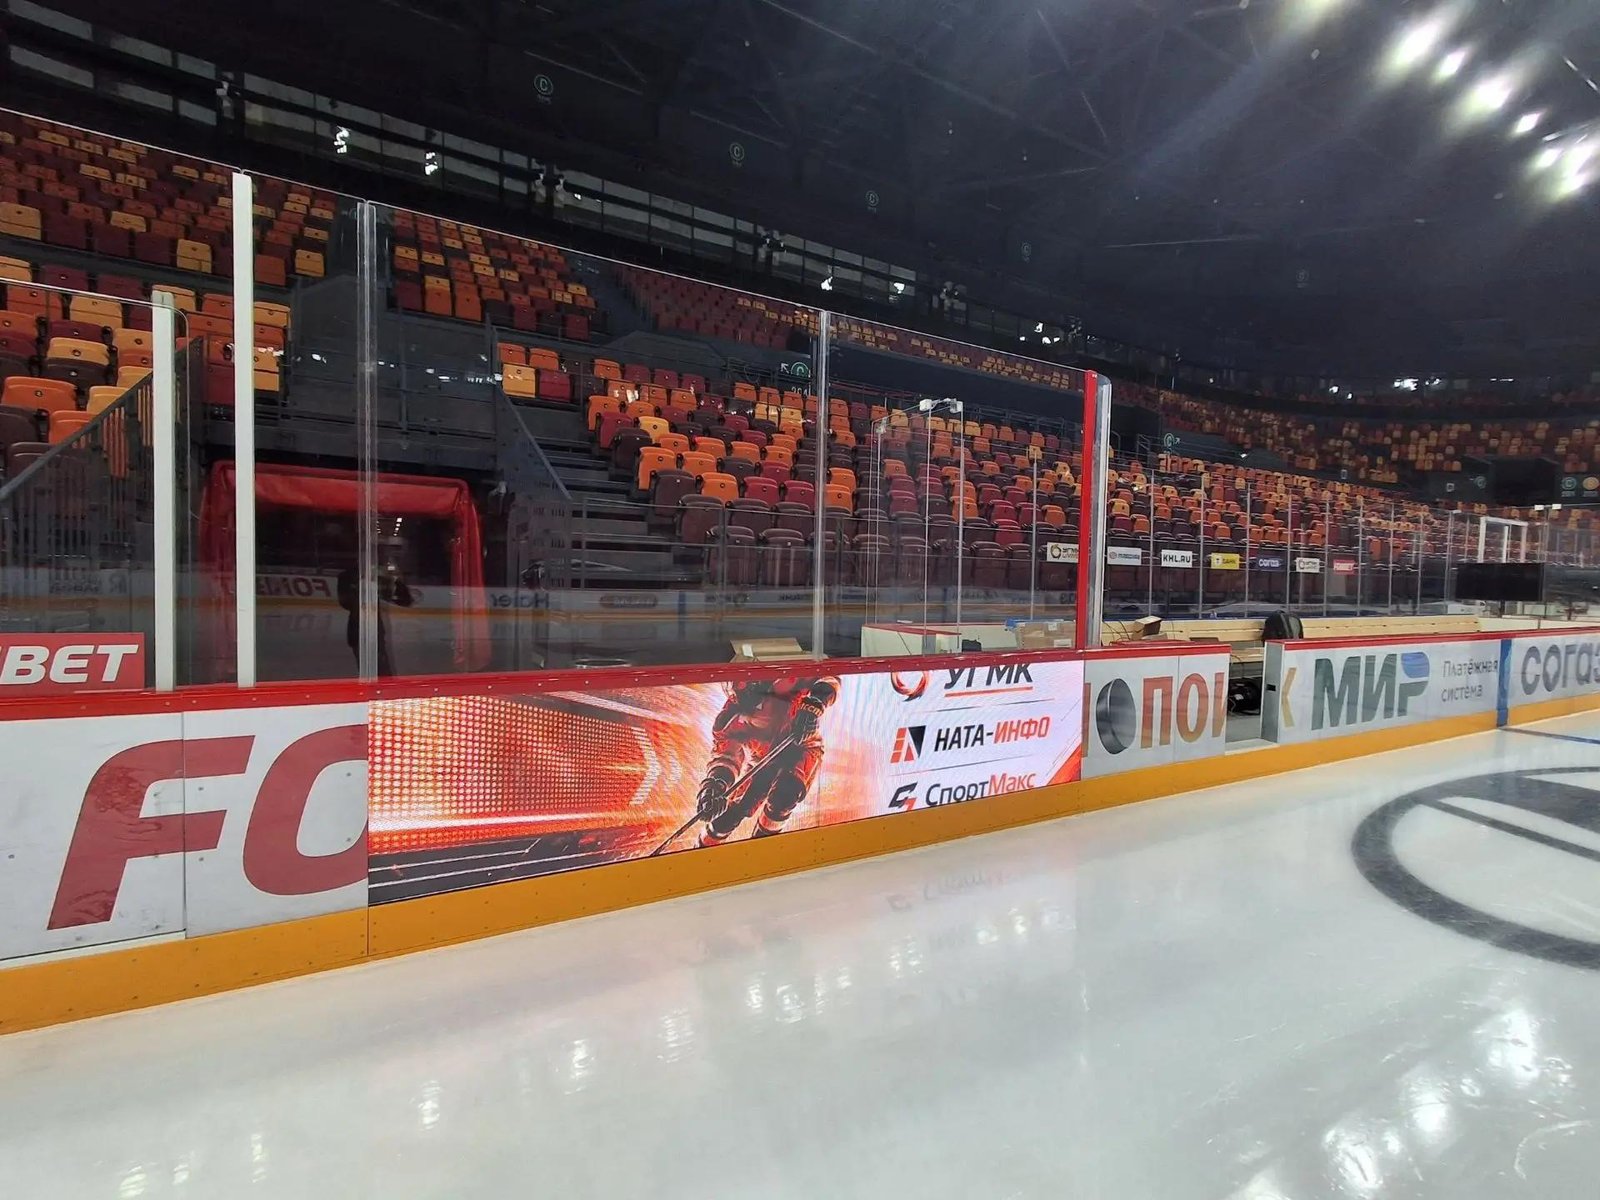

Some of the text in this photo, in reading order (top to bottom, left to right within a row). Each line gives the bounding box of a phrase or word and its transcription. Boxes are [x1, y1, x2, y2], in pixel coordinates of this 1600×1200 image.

[1162, 554, 1192, 563] KHL.RU
[0, 644, 139, 685] BET
[1311, 651, 1430, 730] МИР
[935, 716, 1050, 752] НАТА-ИНФО
[925, 772, 1037, 807] СпортМакс
